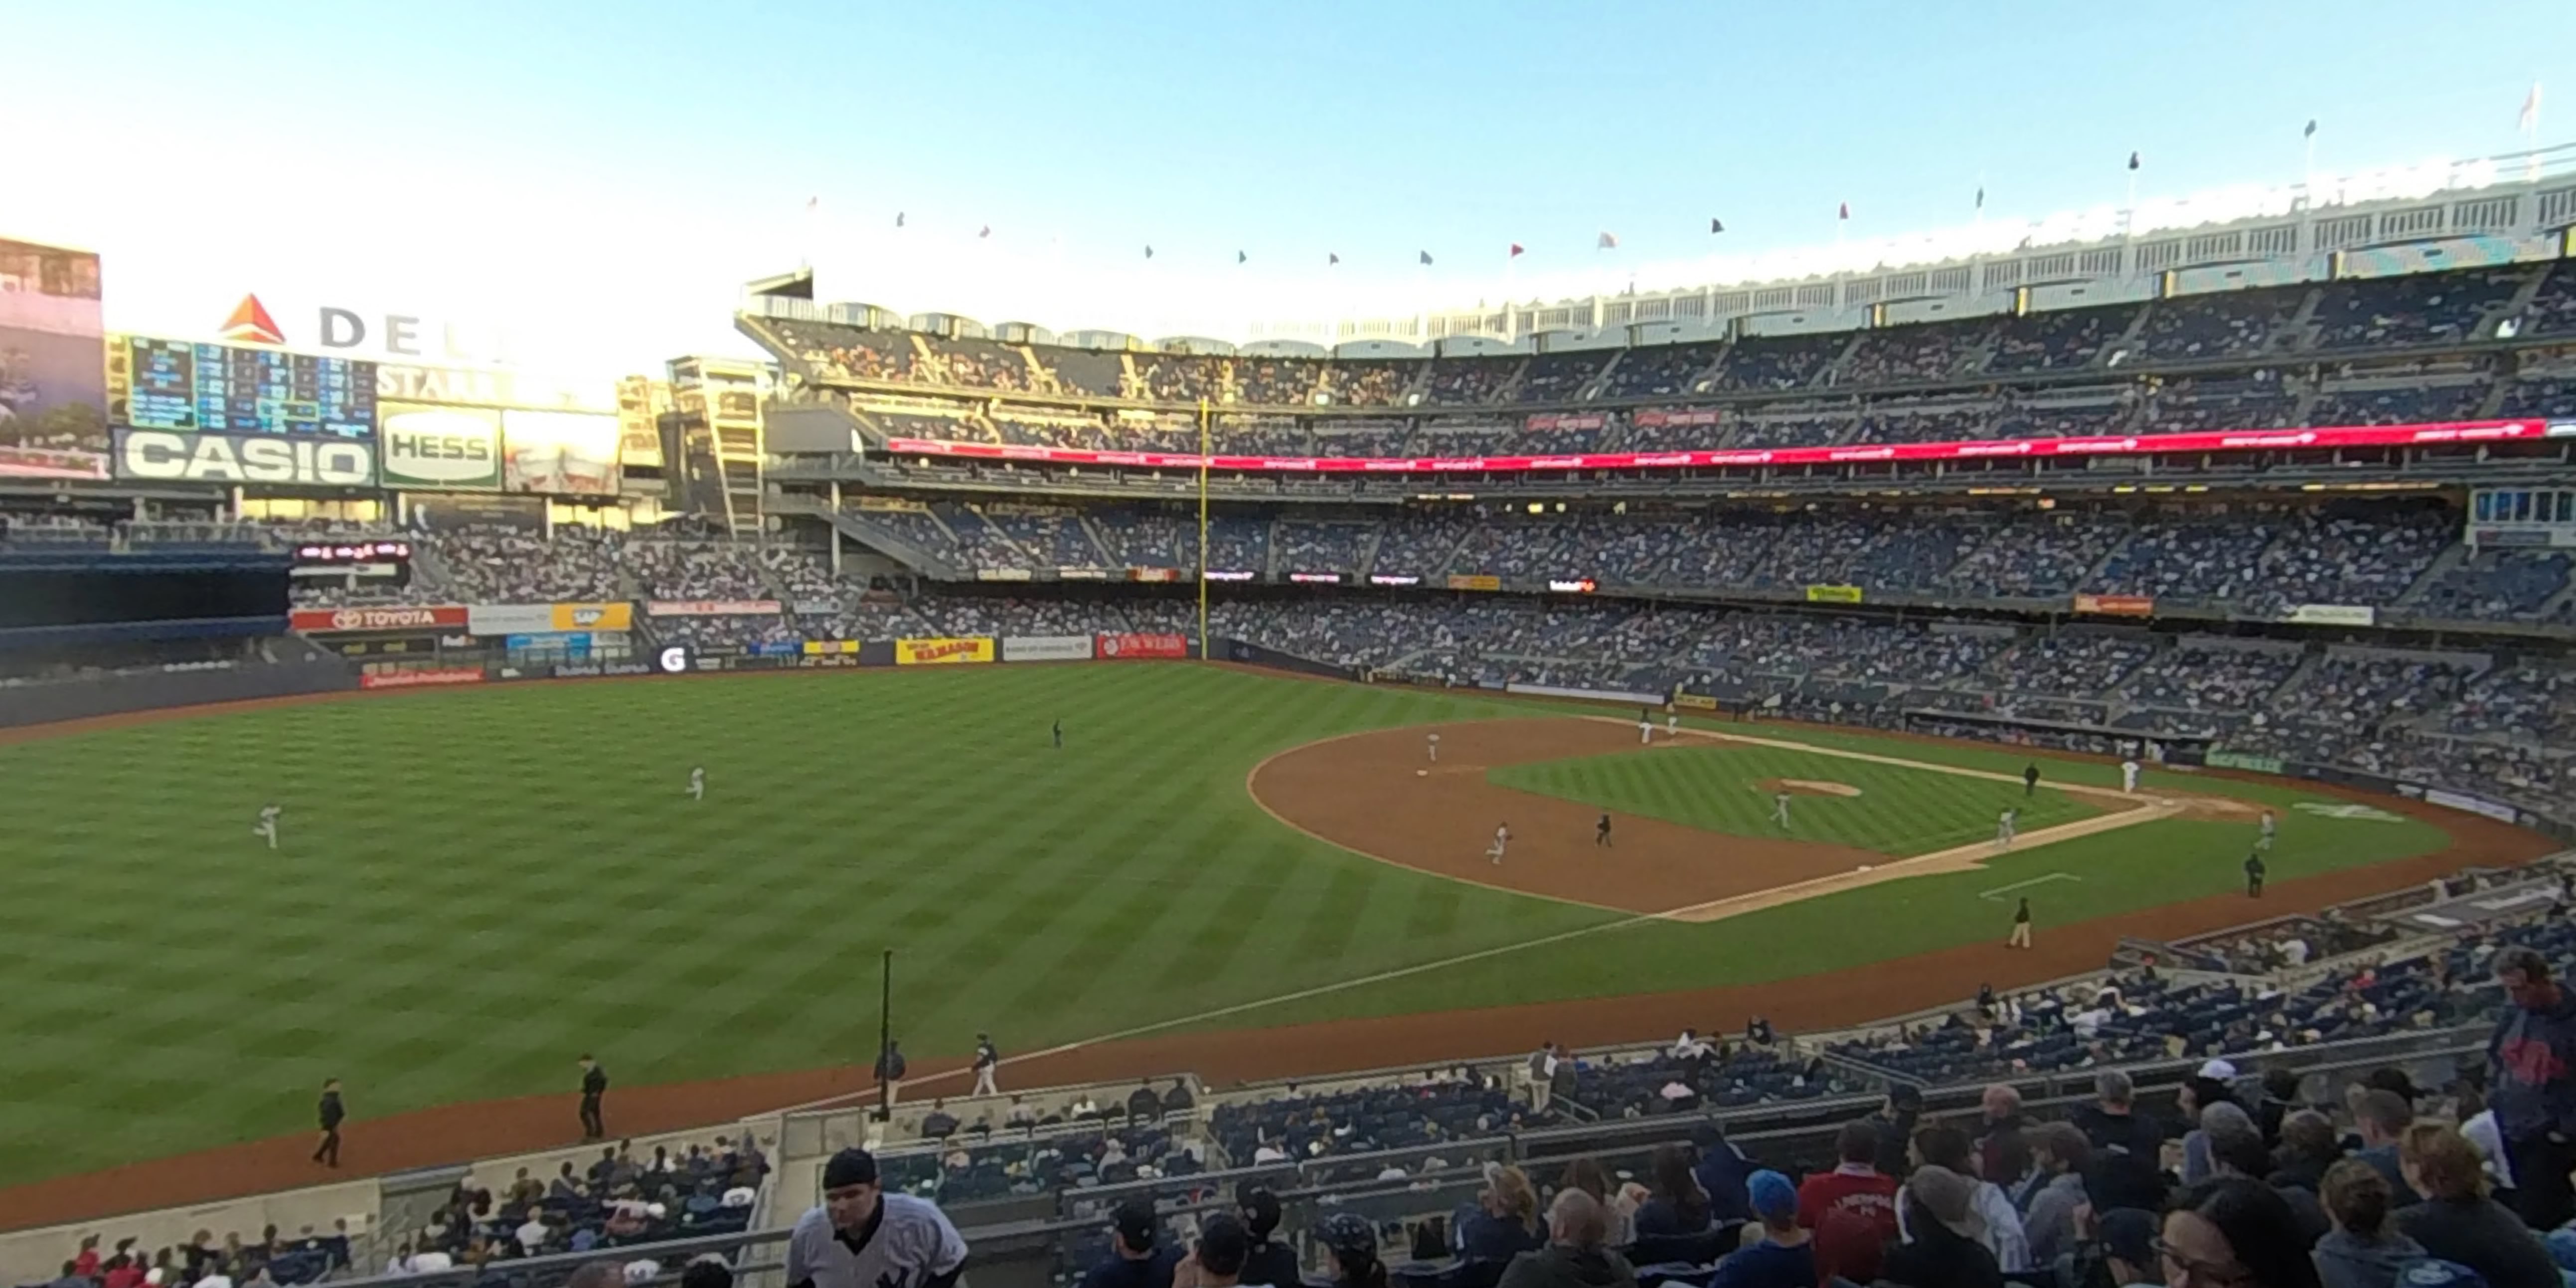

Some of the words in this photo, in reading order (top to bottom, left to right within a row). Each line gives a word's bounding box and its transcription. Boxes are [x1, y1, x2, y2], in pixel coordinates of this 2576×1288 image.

[126, 432, 370, 484] CASIO
[392, 433, 487, 461] HESS
[365, 611, 434, 626] TOYOTA
[661, 647, 686, 671] G
